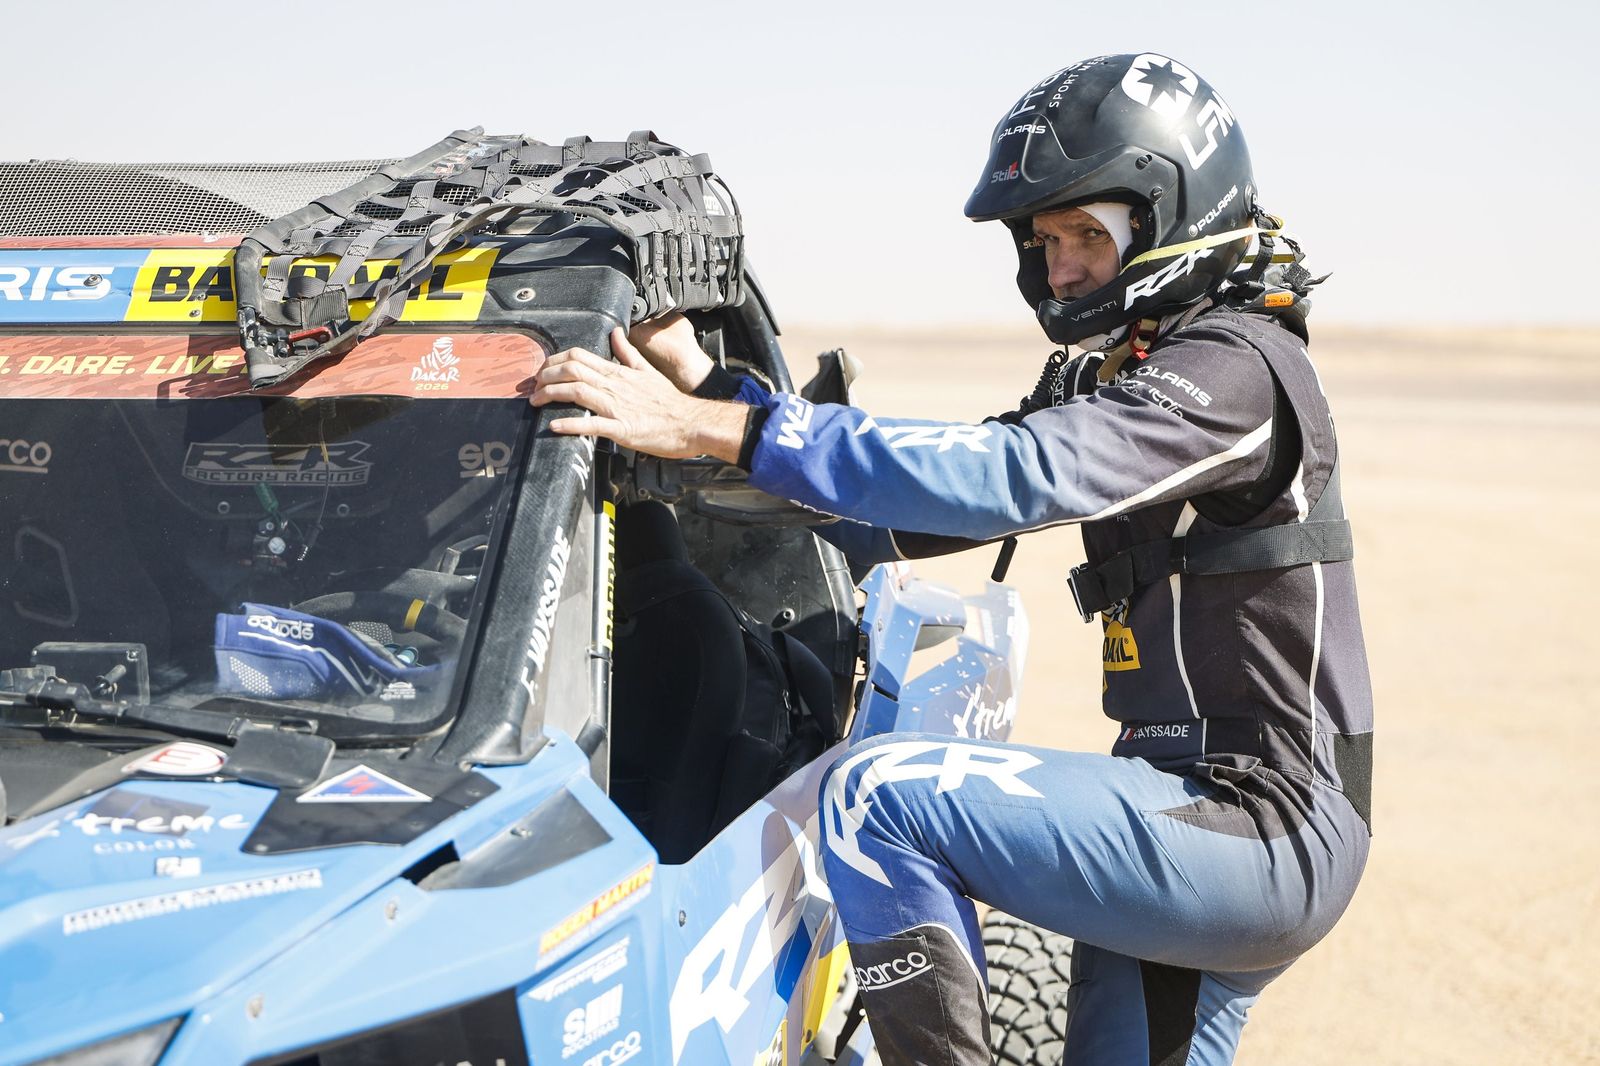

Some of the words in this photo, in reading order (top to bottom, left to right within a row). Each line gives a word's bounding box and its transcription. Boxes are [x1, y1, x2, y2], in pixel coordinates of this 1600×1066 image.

[1048, 72, 1080, 109] SPORT
[997, 124, 1047, 143] POLARIS
[991, 164, 1020, 184] Stilo
[1197, 184, 1238, 231] POLARIS
[1070, 300, 1117, 322] VENTI
[19, 355, 136, 375] DARE.
[144, 355, 240, 375] LIVE
[410, 366, 460, 383] DAKAR
[415, 382, 449, 391] 2026
[1133, 365, 1213, 407] OLARIS
[185, 467, 280, 482] FACTORY
[288, 470, 366, 483] RACING
[94, 838, 197, 854] COLOR
